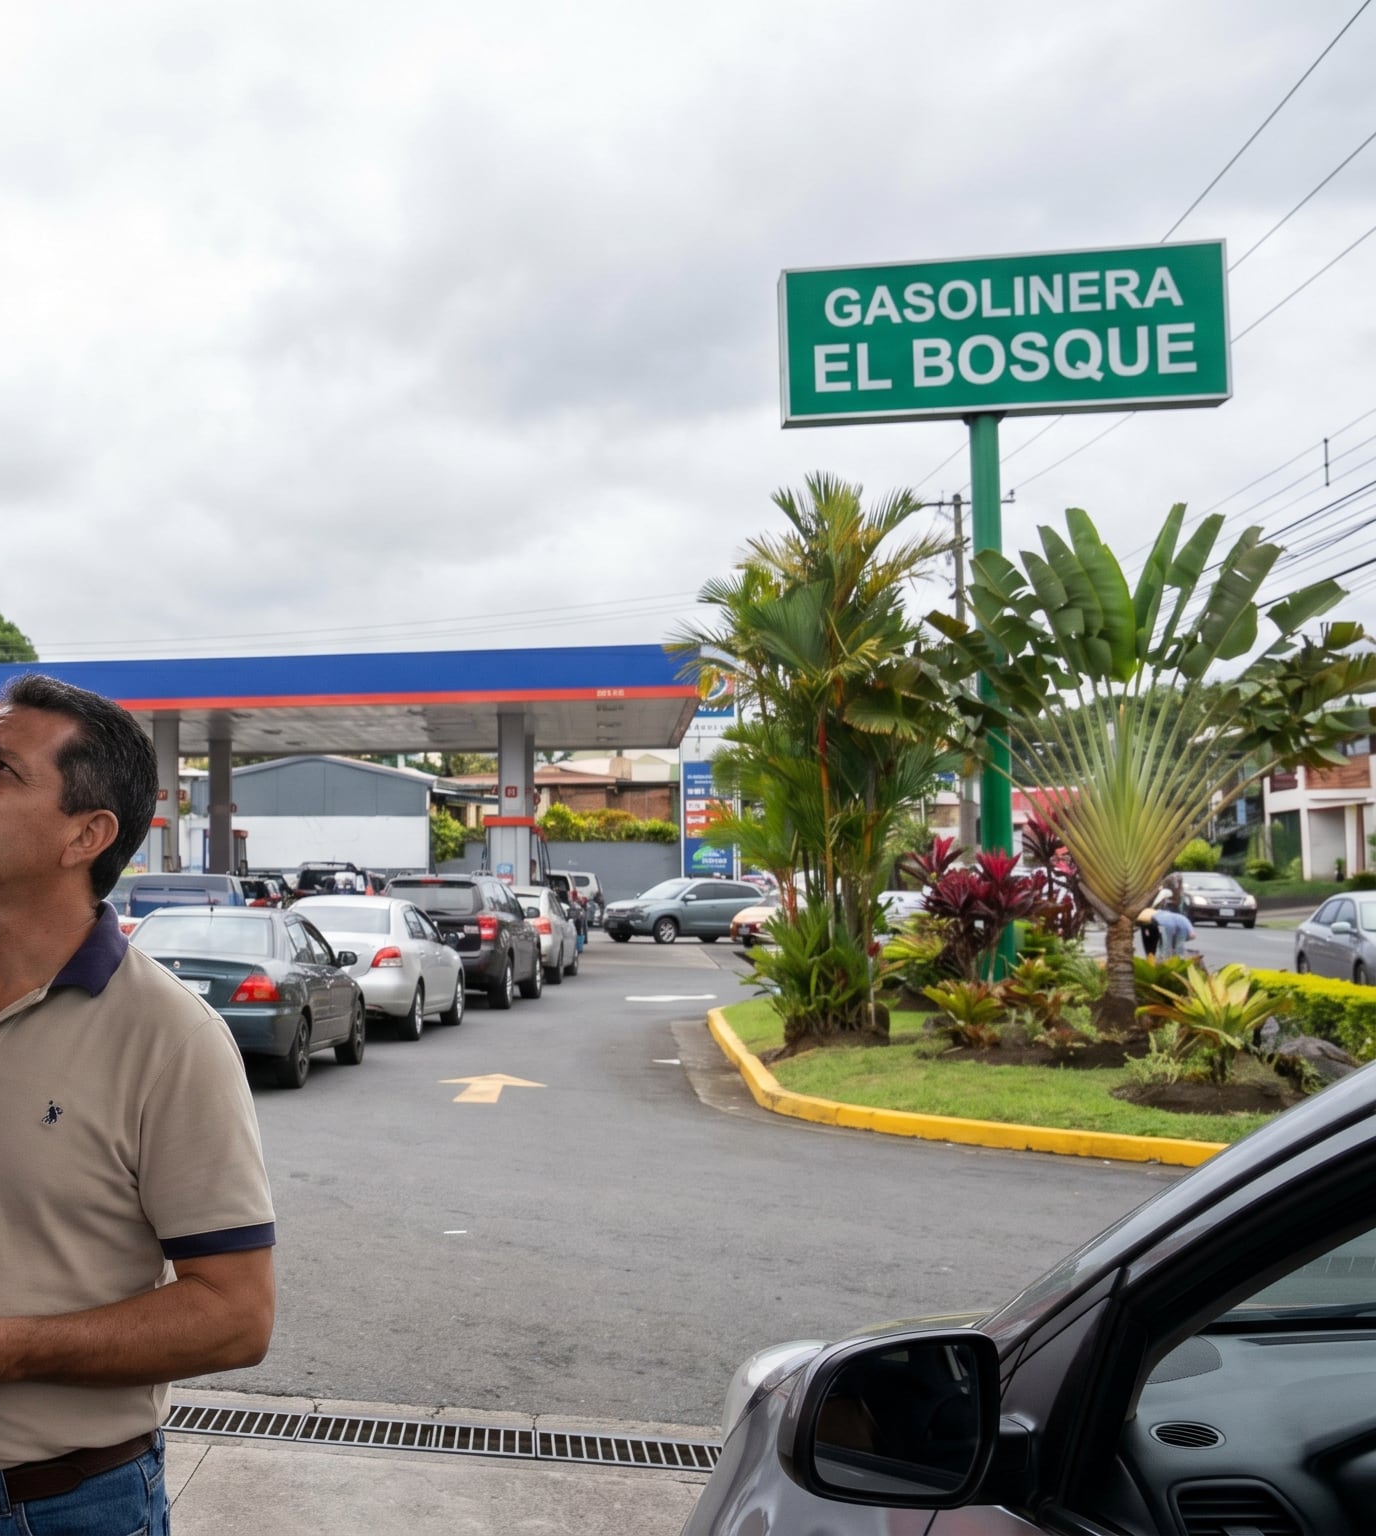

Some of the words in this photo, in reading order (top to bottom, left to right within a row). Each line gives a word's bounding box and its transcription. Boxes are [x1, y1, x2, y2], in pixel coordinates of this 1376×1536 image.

[824, 266, 1185, 328] GASOLINERA
[813, 342, 893, 393] EL
[911, 321, 1198, 388] BOSQUE
